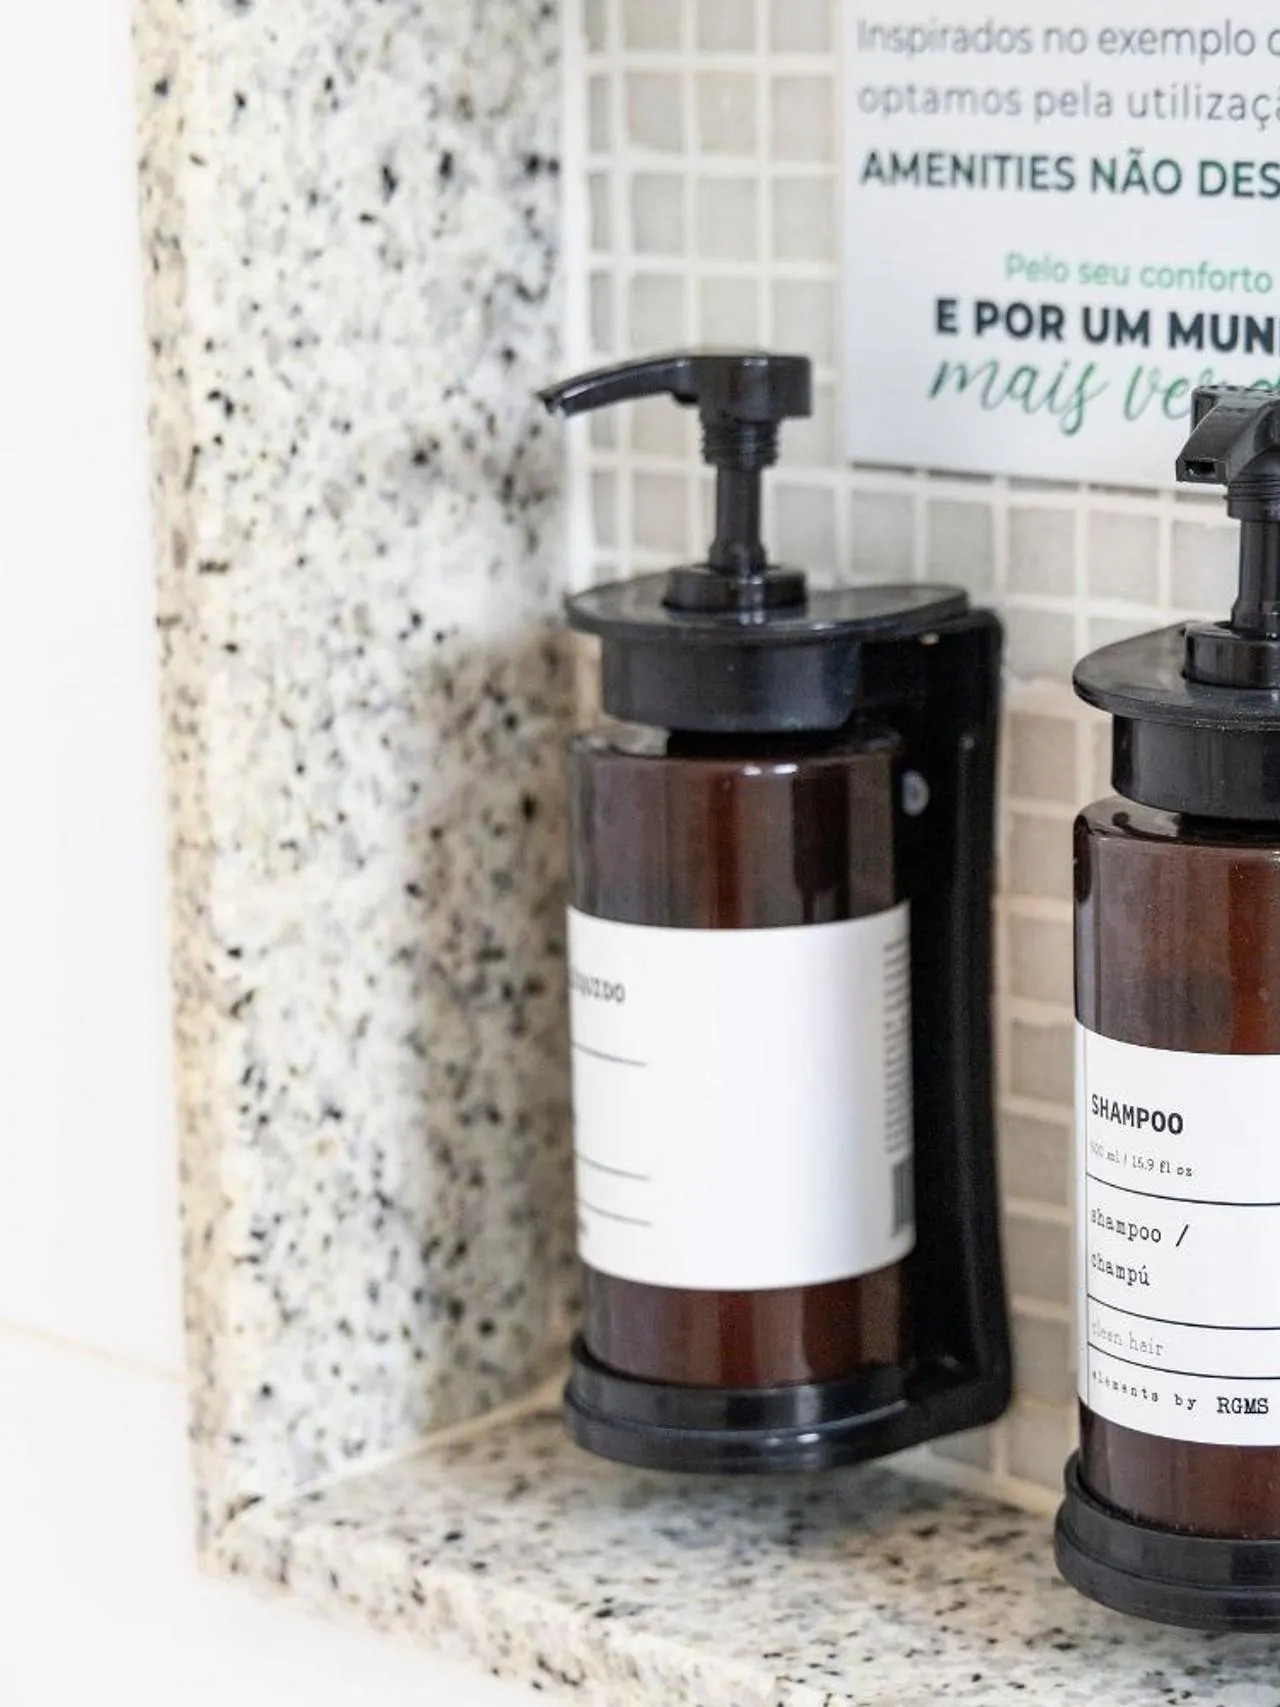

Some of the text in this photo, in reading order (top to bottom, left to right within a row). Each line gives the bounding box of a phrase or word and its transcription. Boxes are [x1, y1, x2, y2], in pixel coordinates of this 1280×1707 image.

[857, 18, 1033, 59] Inspirados
[1043, 29, 1087, 55] no
[1097, 20, 1256, 63] exemplo
[857, 84, 1022, 120] optamos
[1033, 81, 1112, 122] pela
[859, 150, 1076, 192] AMENITIES
[1090, 147, 1182, 196] NÃO
[1005, 252, 1273, 294] Pelo seu conforto
[935, 299, 958, 334] E
[974, 300, 1064, 342] POR
[1083, 307, 1150, 347] UM
[927, 358, 1104, 436] mais
[1091, 1093, 1184, 1135] SHAMPOO
[1160, 1160, 1170, 1173] fl
[1176, 1166, 1192, 1177] oz
[1091, 1207, 1189, 1247] shampoo /
[1091, 1252, 1150, 1286] champú
[1128, 1330, 1163, 1356] hair
[1092, 1370, 1270, 1416] elements by RGMS
